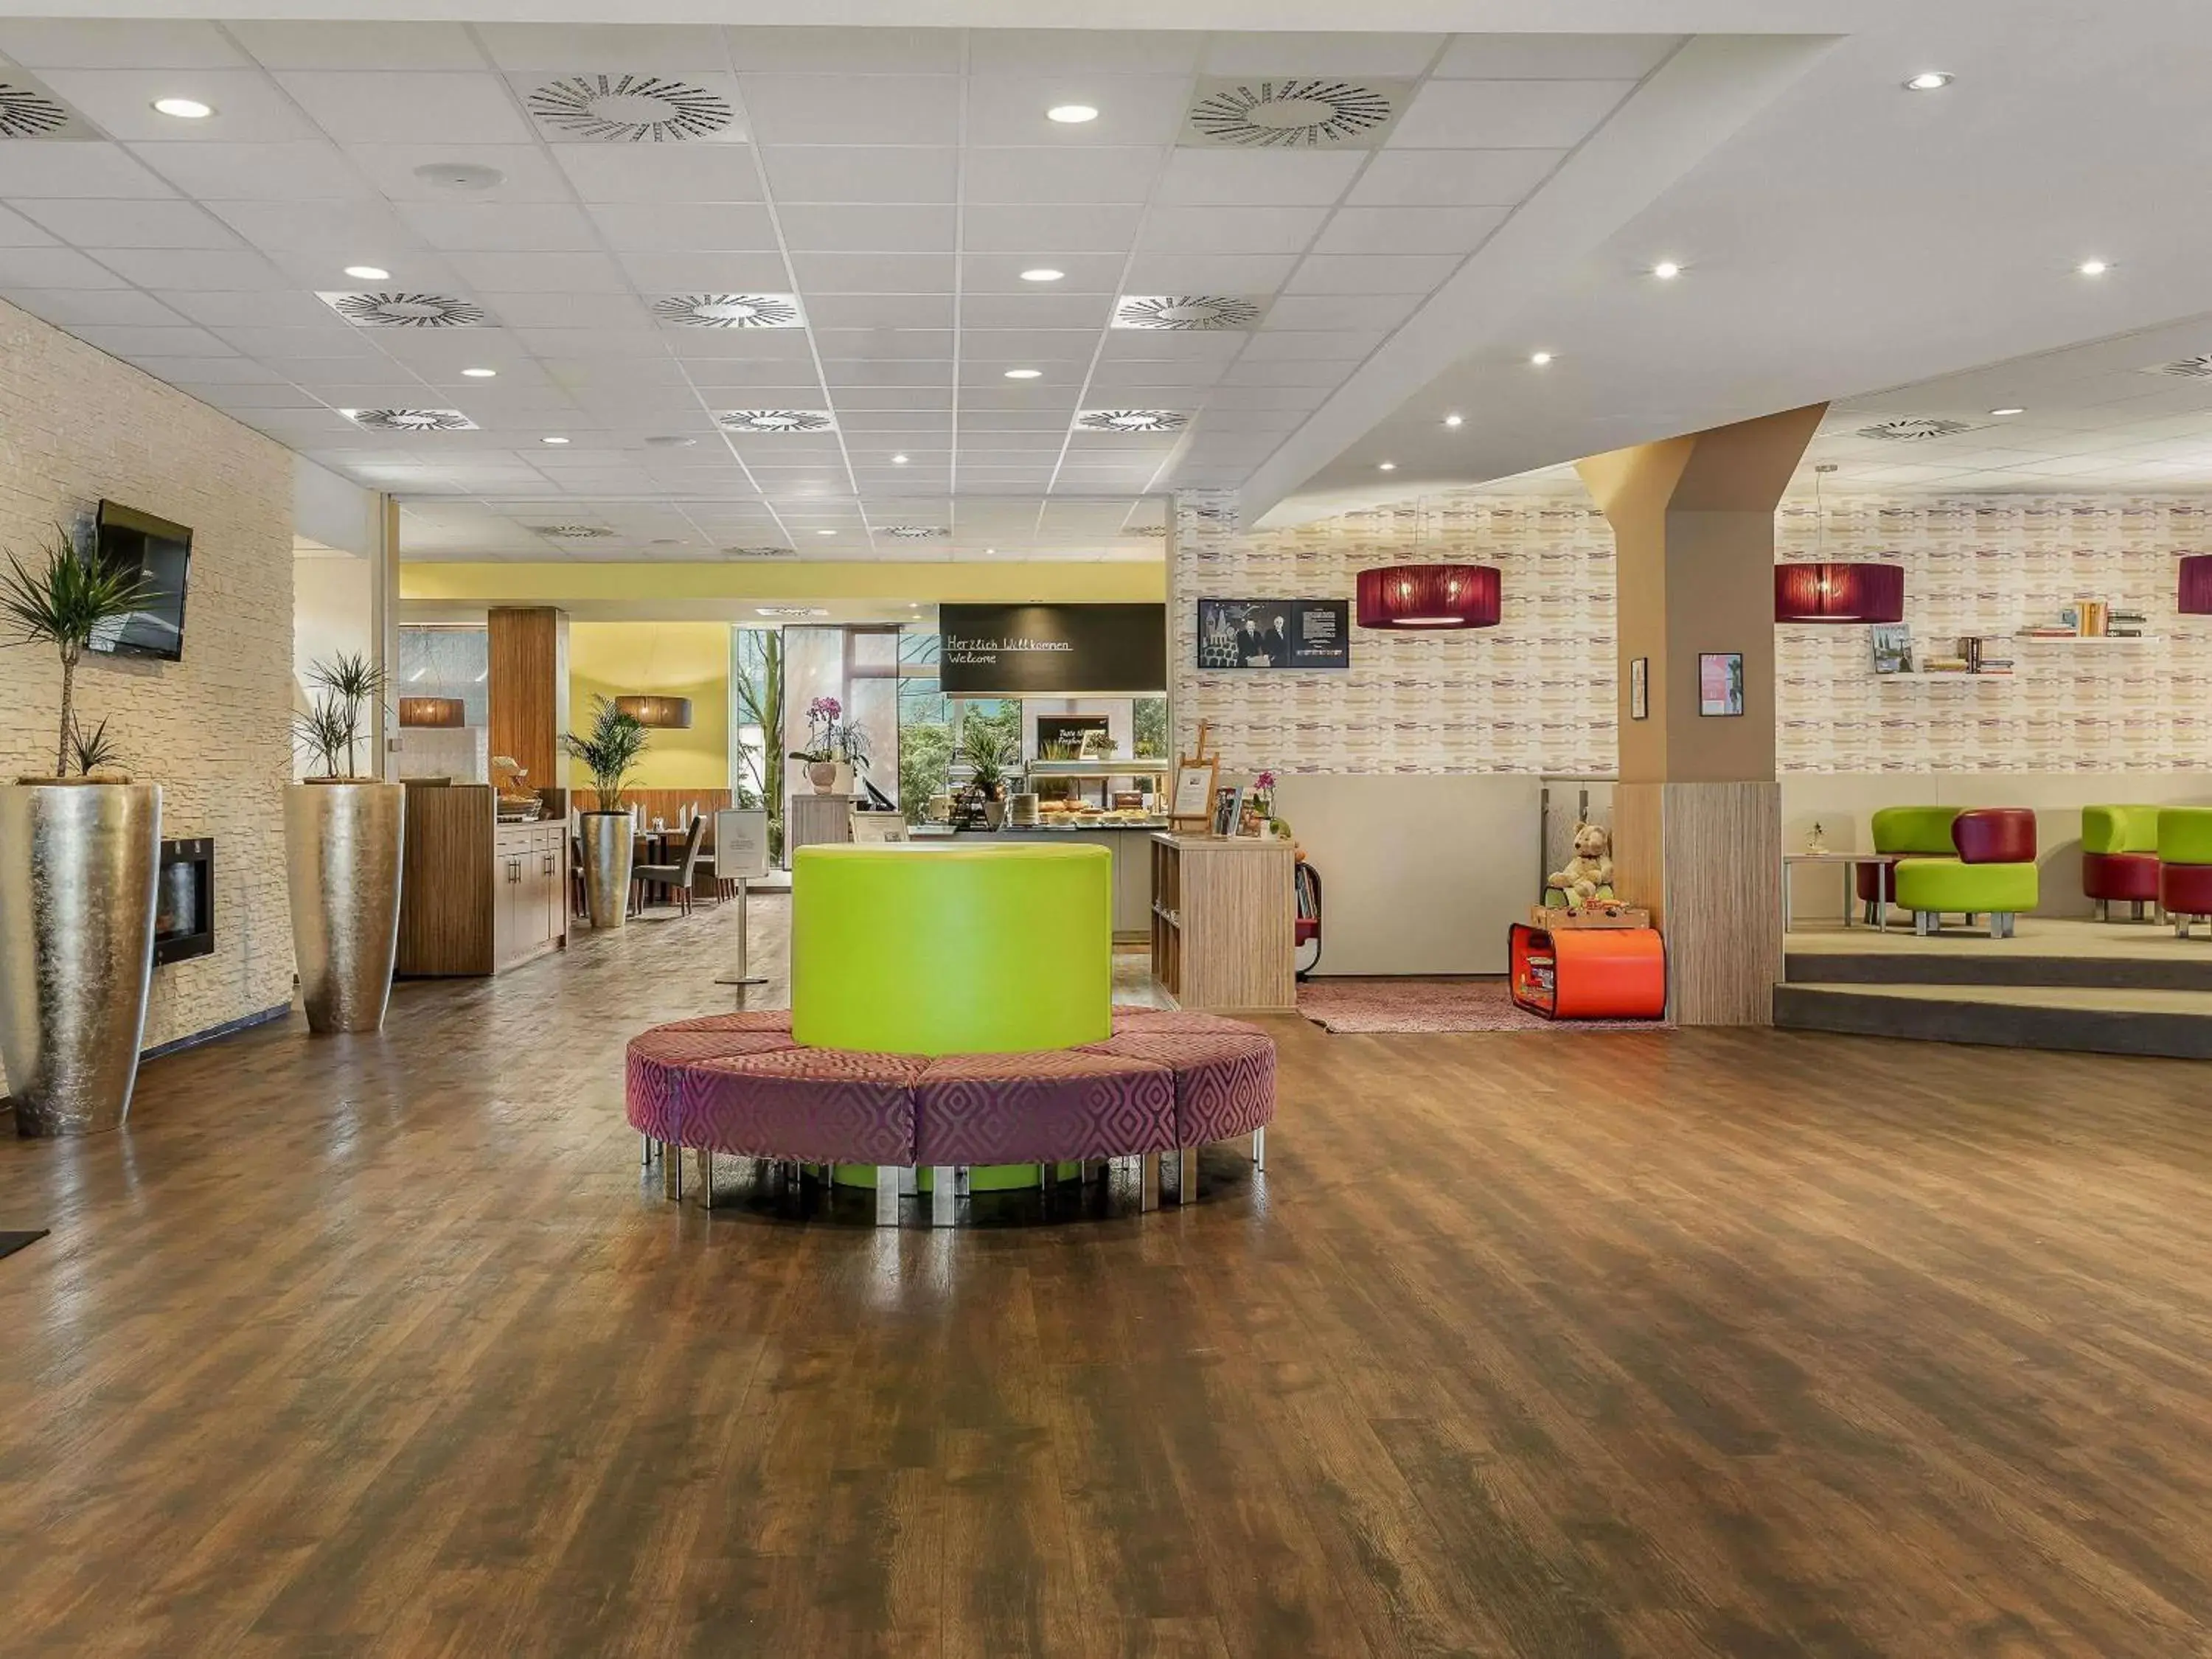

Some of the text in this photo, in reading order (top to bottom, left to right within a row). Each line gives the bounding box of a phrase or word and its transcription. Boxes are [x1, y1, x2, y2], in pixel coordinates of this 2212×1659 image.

[947, 635, 1069, 650] Herzlich Willkommen
[948, 652, 996, 664] Welcome
